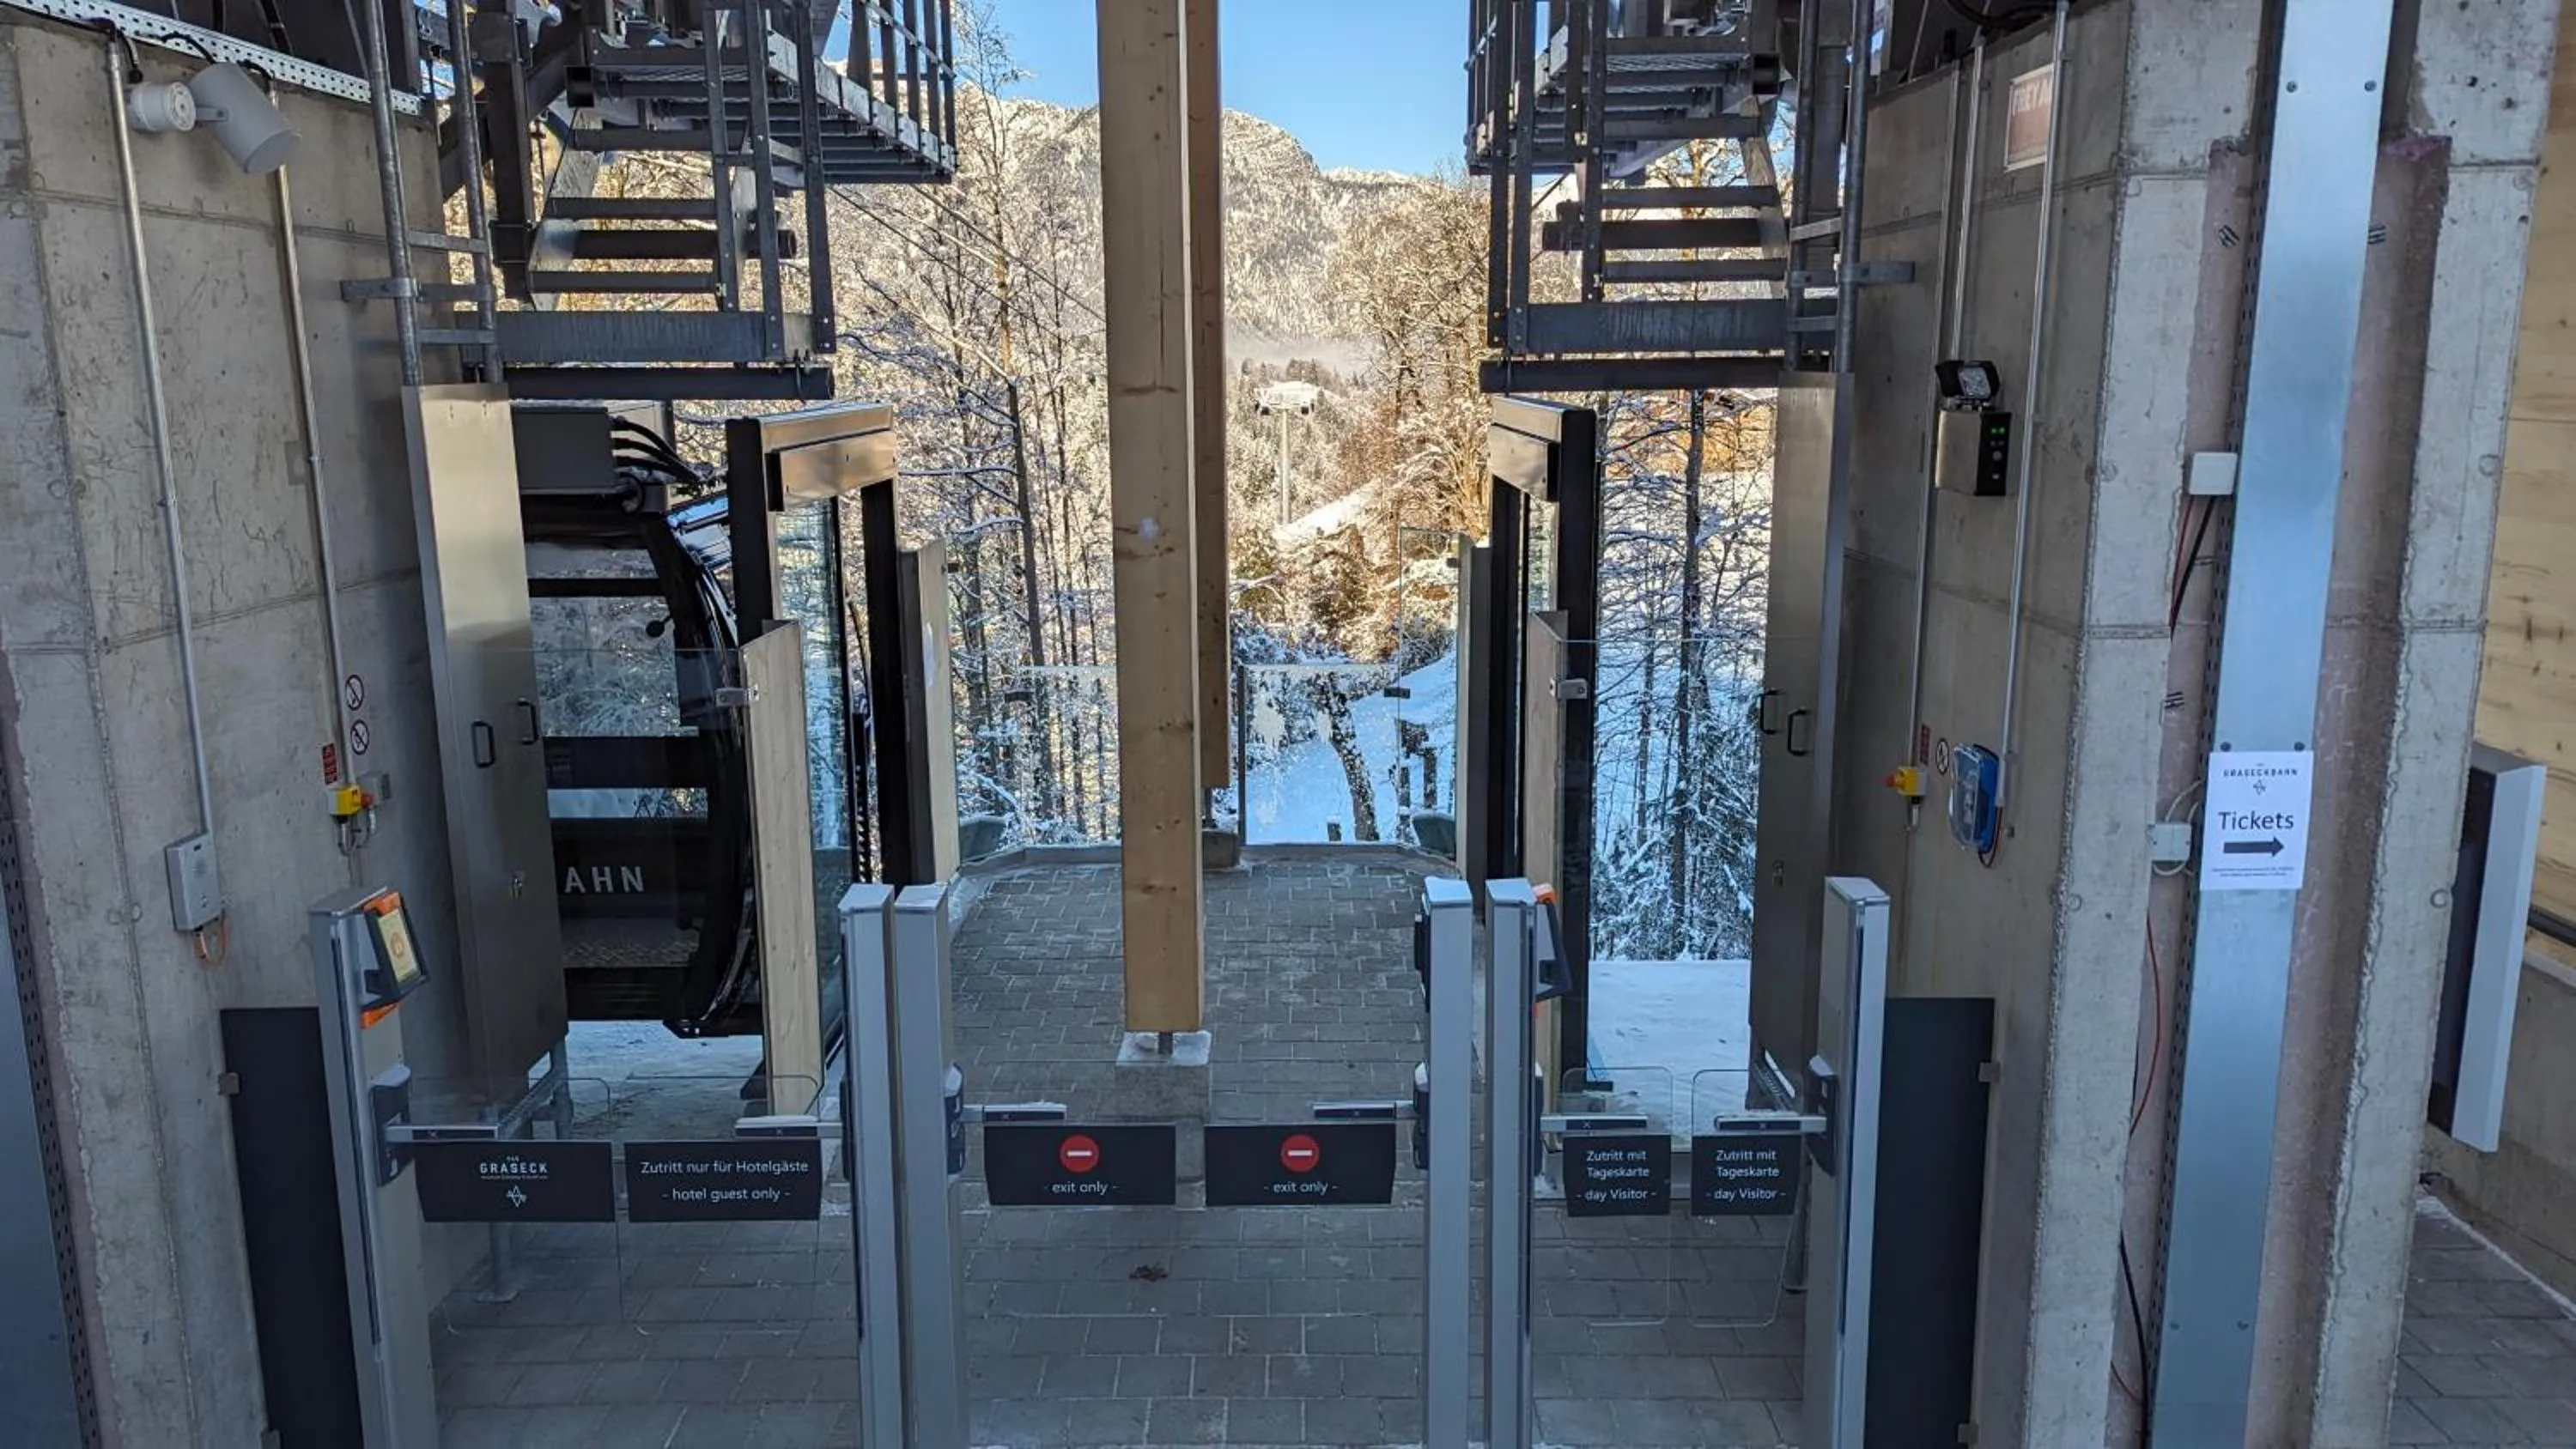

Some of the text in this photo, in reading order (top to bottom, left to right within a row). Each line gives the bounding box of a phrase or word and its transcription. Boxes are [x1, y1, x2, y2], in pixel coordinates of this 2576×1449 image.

[2218, 810, 2294, 831] Tickets
[1586, 1150, 1647, 1161] Zutritt mit
[1716, 1149, 1777, 1161] Zutritt mit
[480, 1162, 547, 1173] GRASECK
[641, 1160, 809, 1175] Zutritt nur für Hotelgäste
[1587, 1167, 1650, 1180] Tageskarte
[1716, 1166, 1780, 1180] Tageskarte
[672, 1187, 707, 1201] hotel
[710, 1189, 749, 1203] guest
[751, 1187, 781, 1203] only
[1052, 1180, 1076, 1193] exit
[1079, 1180, 1109, 1196] only
[1273, 1180, 1297, 1193] exit
[1299, 1180, 1329, 1196] only
[1584, 1190, 1607, 1203] day
[1609, 1188, 1648, 1200] Visitor
[1714, 1188, 1736, 1203] day
[1739, 1188, 1777, 1199] Visitor
